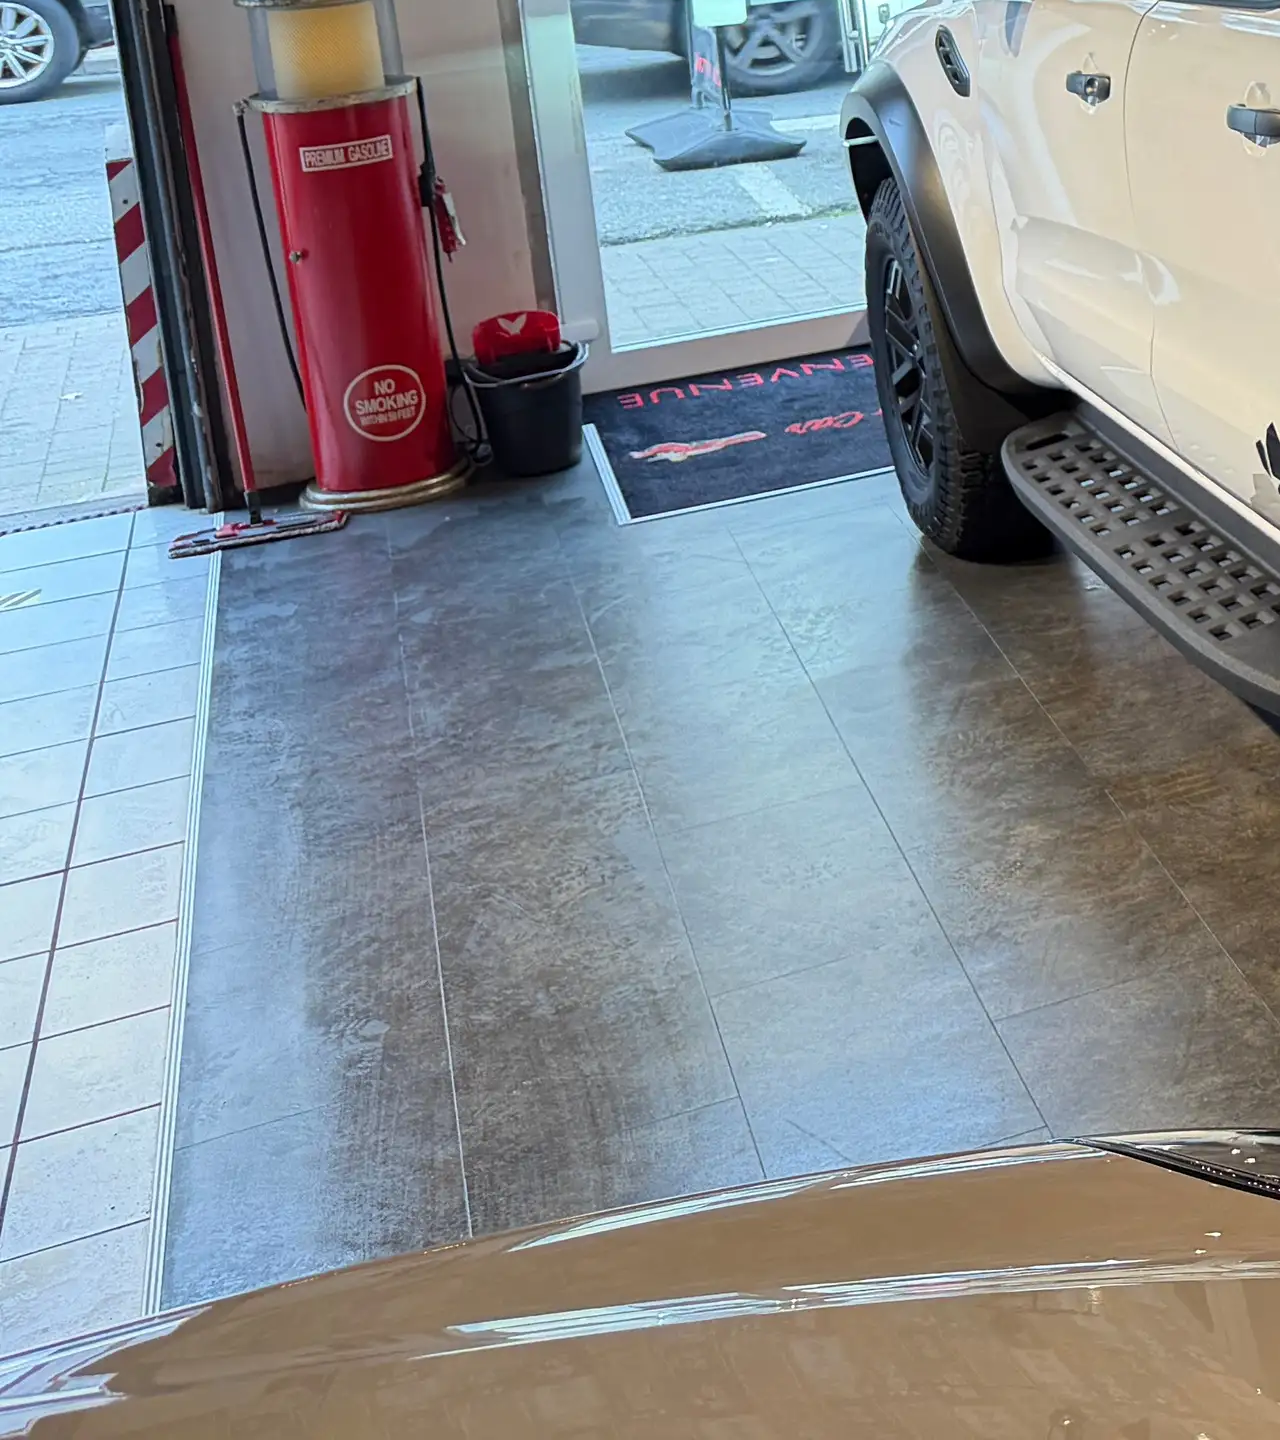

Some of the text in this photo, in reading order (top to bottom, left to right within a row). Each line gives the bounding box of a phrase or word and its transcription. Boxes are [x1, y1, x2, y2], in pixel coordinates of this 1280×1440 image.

[304, 136, 390, 170] PREMIUM GASOLINE
[373, 378, 396, 396] NO
[355, 389, 418, 417] SMOKING
